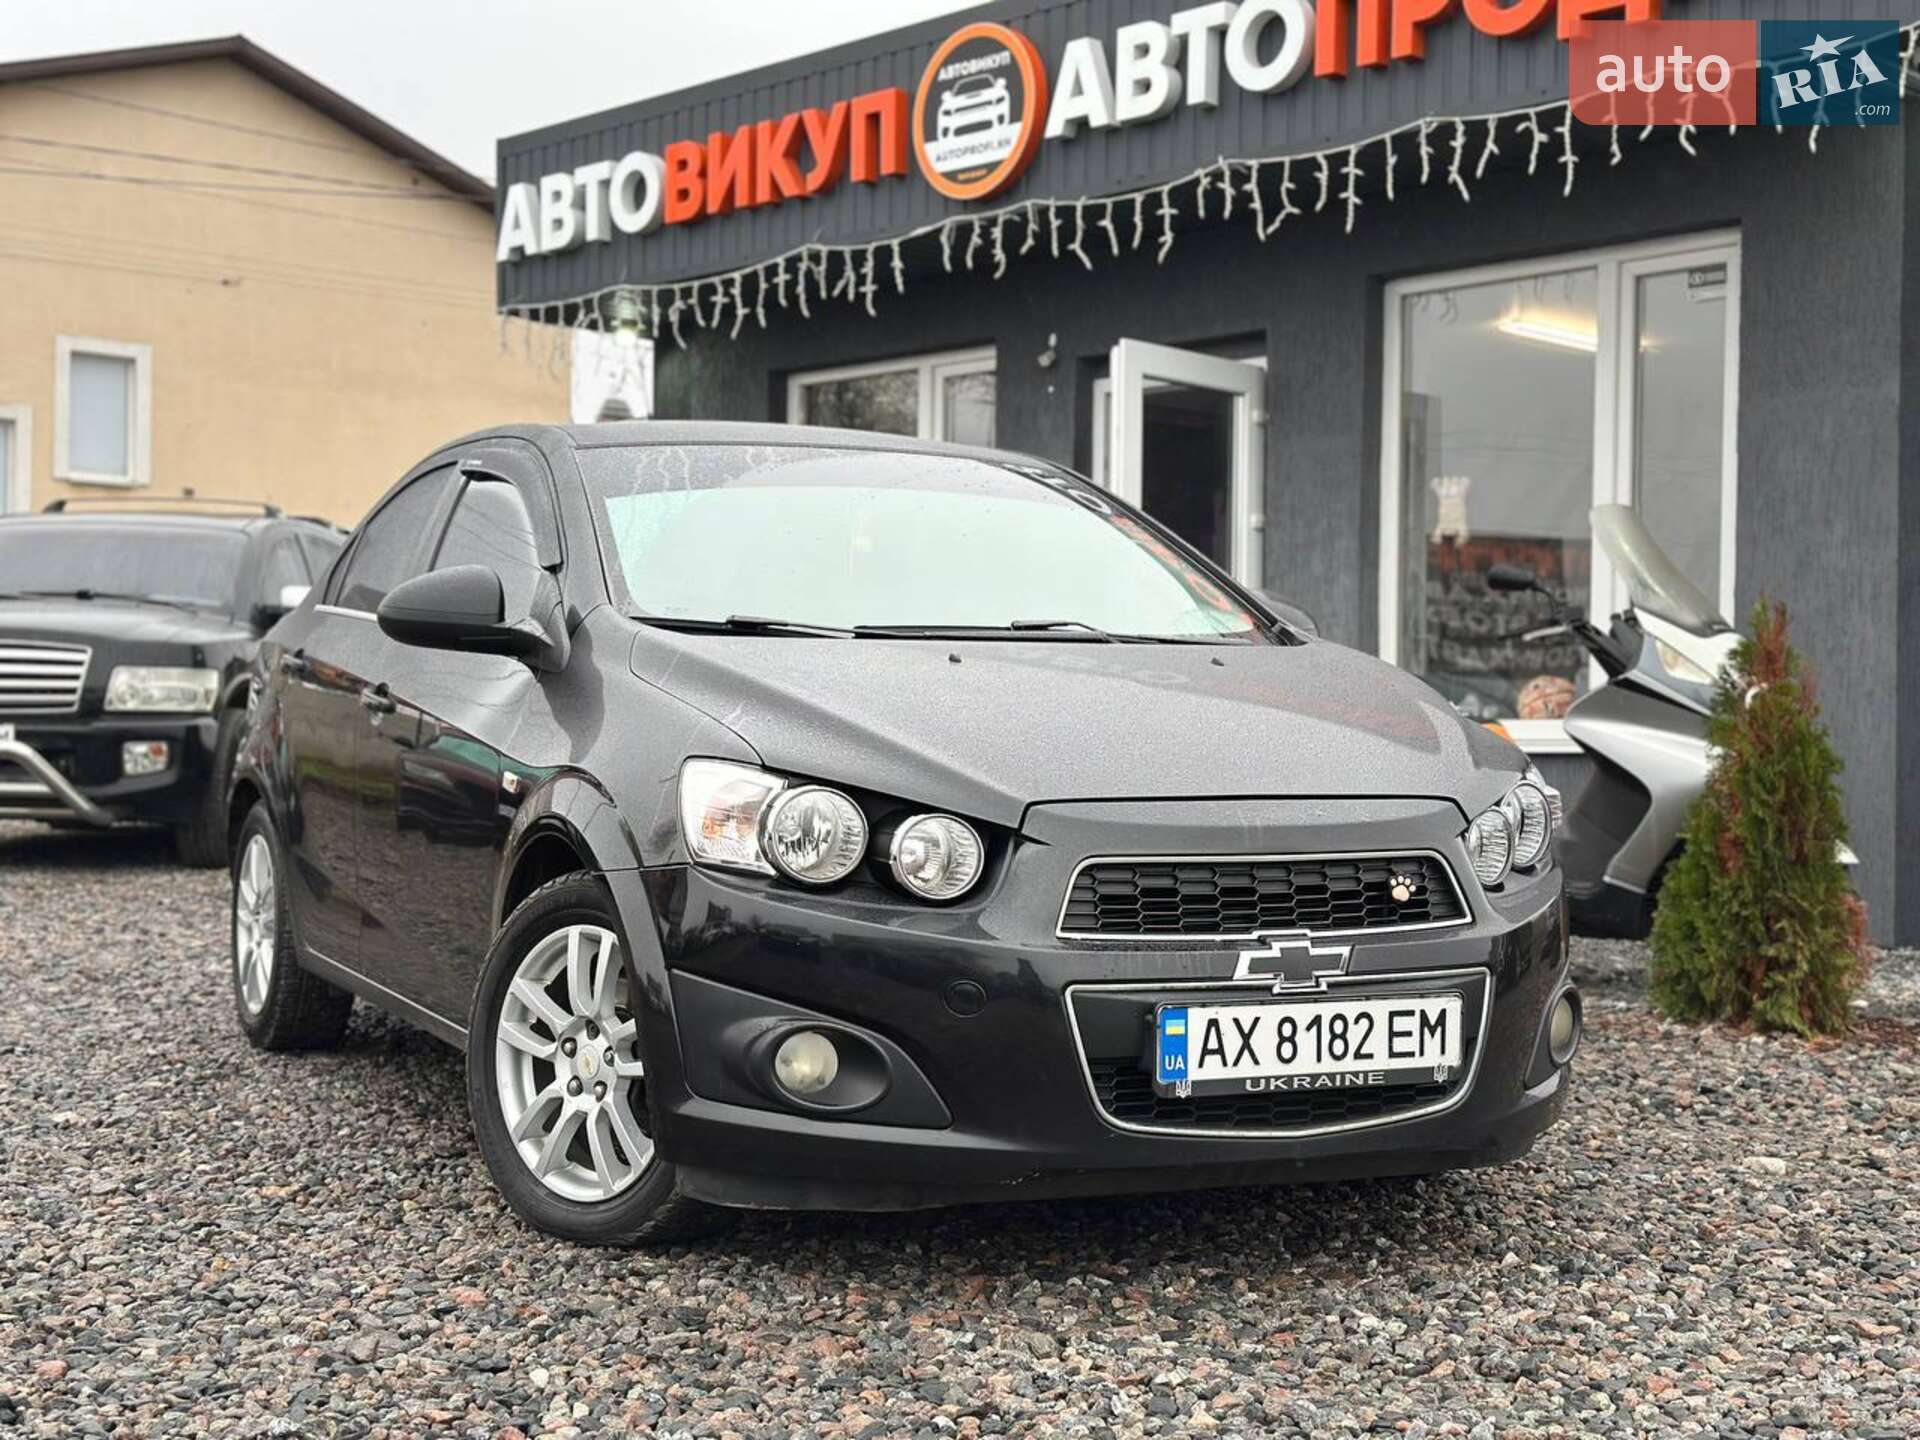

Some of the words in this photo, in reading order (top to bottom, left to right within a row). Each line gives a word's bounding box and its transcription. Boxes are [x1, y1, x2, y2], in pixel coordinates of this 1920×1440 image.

[938, 50, 1011, 82] АВТОВИКУП
[496, 86, 908, 263] АВТОВИКУП
[1198, 1016, 1261, 1068] AX
[1276, 1012, 1374, 1065] 8182
[1388, 1008, 1447, 1058] EM
[1165, 1056, 1185, 1071] UA
[1245, 1071, 1385, 1092] UKRAINE
